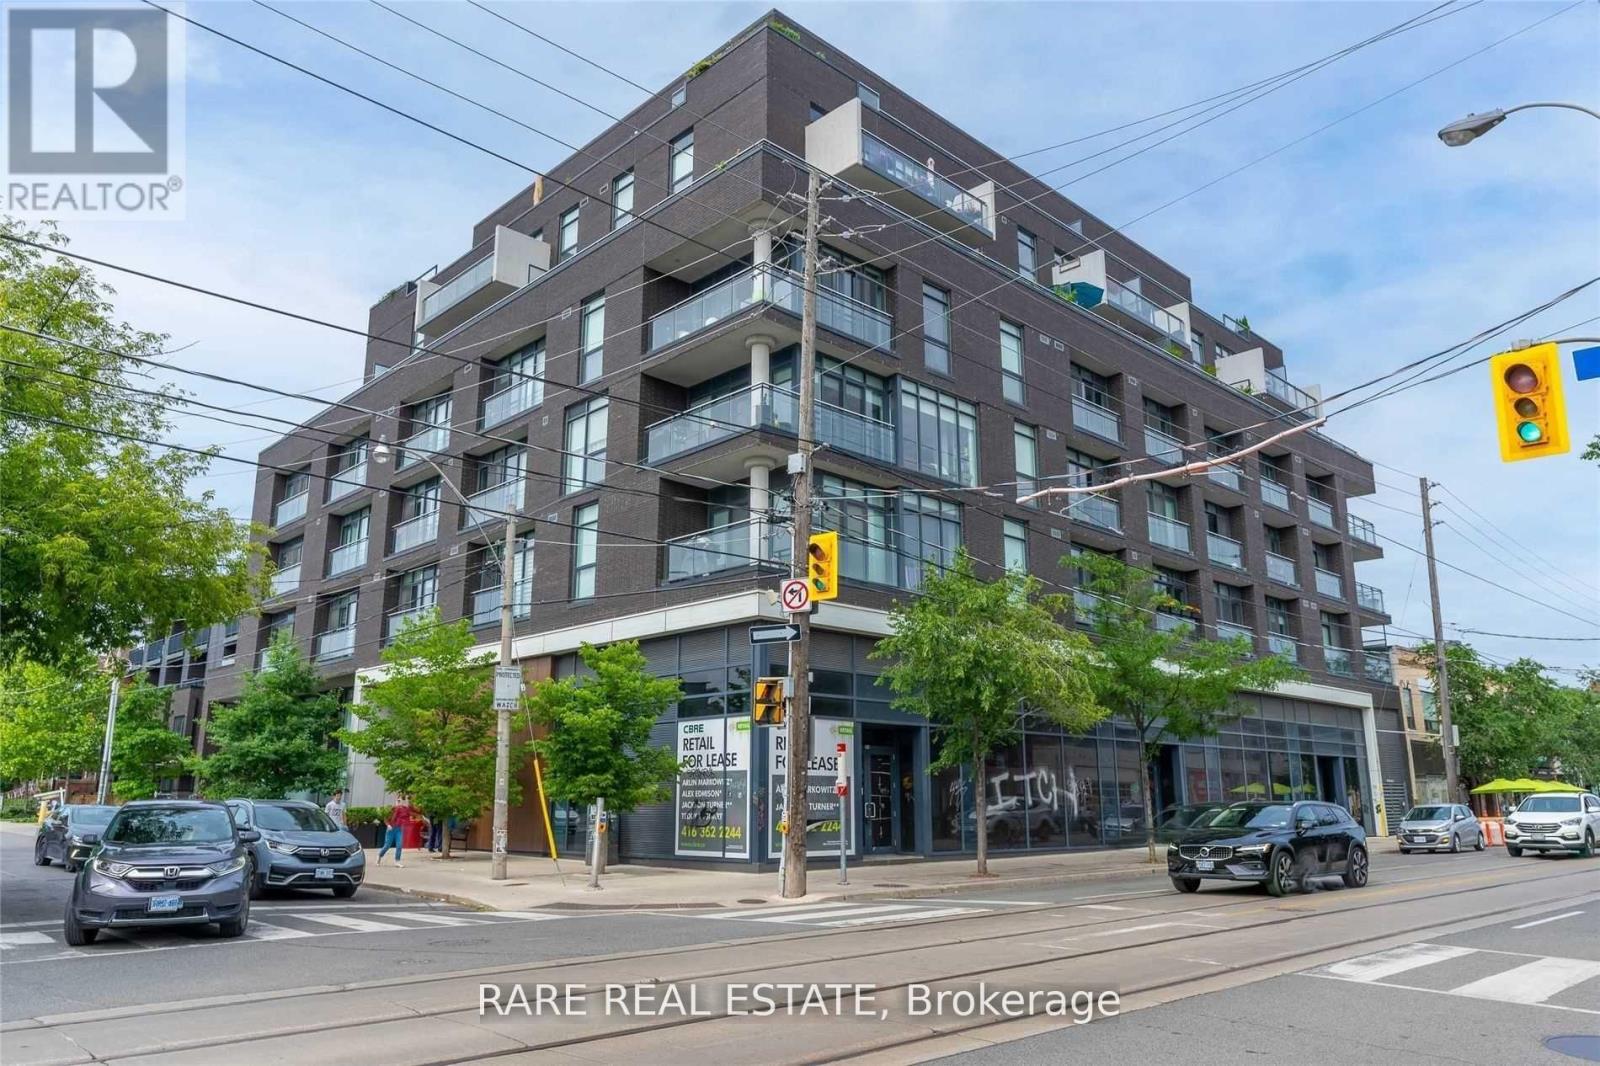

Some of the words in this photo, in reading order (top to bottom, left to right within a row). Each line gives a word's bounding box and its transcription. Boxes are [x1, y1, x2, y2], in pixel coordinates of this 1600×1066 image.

[683, 724, 705, 734] CBRE
[683, 736, 715, 751] RETAIL
[682, 754, 703, 768] FOR
[706, 752, 738, 767] LEASE
[807, 756, 839, 771] EASE
[682, 790, 695, 798] ALEX
[681, 826, 697, 838] 416
[700, 826, 716, 838] 362
[719, 826, 742, 839] 2244
